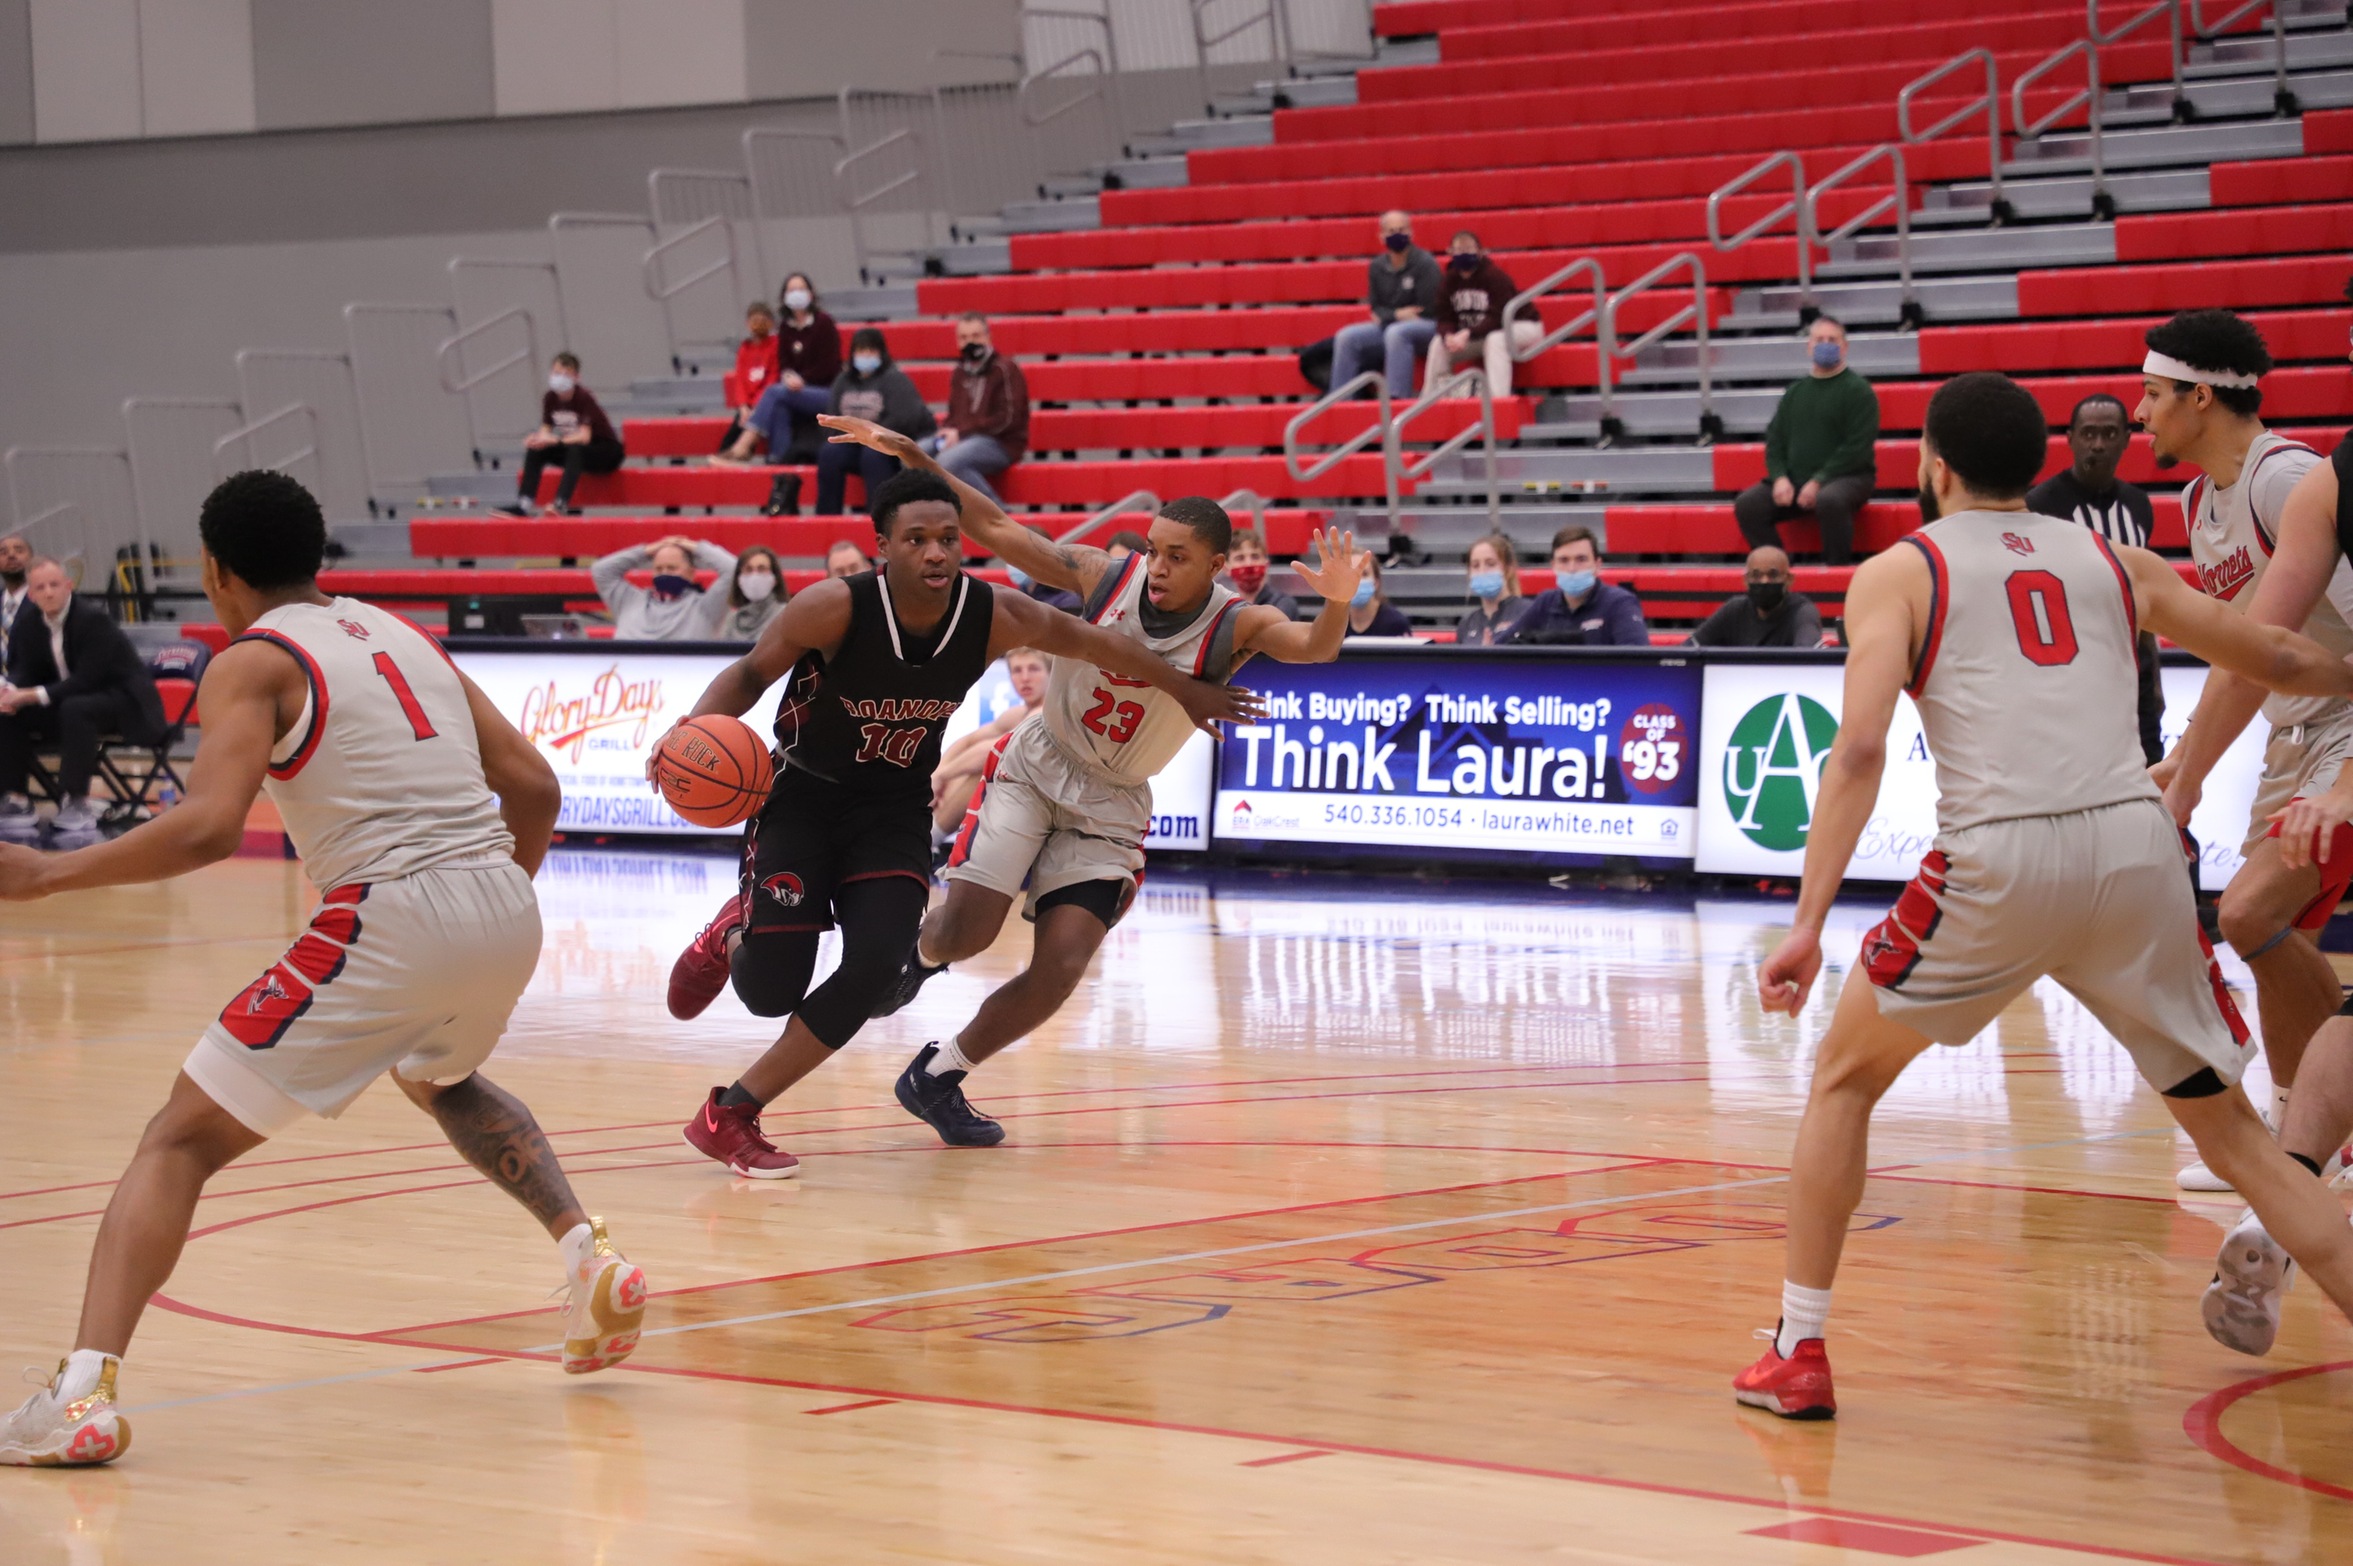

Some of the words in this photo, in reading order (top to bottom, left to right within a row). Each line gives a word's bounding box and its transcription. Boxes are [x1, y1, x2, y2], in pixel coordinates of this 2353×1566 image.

[2198, 545, 2254, 597] Hornets
[2005, 569, 2079, 667] 0
[371, 651, 439, 741] 1
[521, 680, 592, 765] Glory
[594, 662, 665, 749] Days
[1081, 687, 1145, 743] 23
[1309, 692, 1412, 727] Buying?
[1425, 693, 1498, 724] Think
[1504, 695, 1611, 732] Selling?
[588, 738, 631, 751] GRILL
[1633, 714, 1676, 729] CLASS
[1646, 728, 1666, 742] OF
[681, 736, 720, 772] ROCK
[856, 722, 927, 768] 10
[1235, 724, 1397, 791] Think
[1416, 729, 1608, 798] Laura!
[1324, 803, 1462, 829] 540.336.1054
[1482, 809, 1635, 836] laurawhite.net
